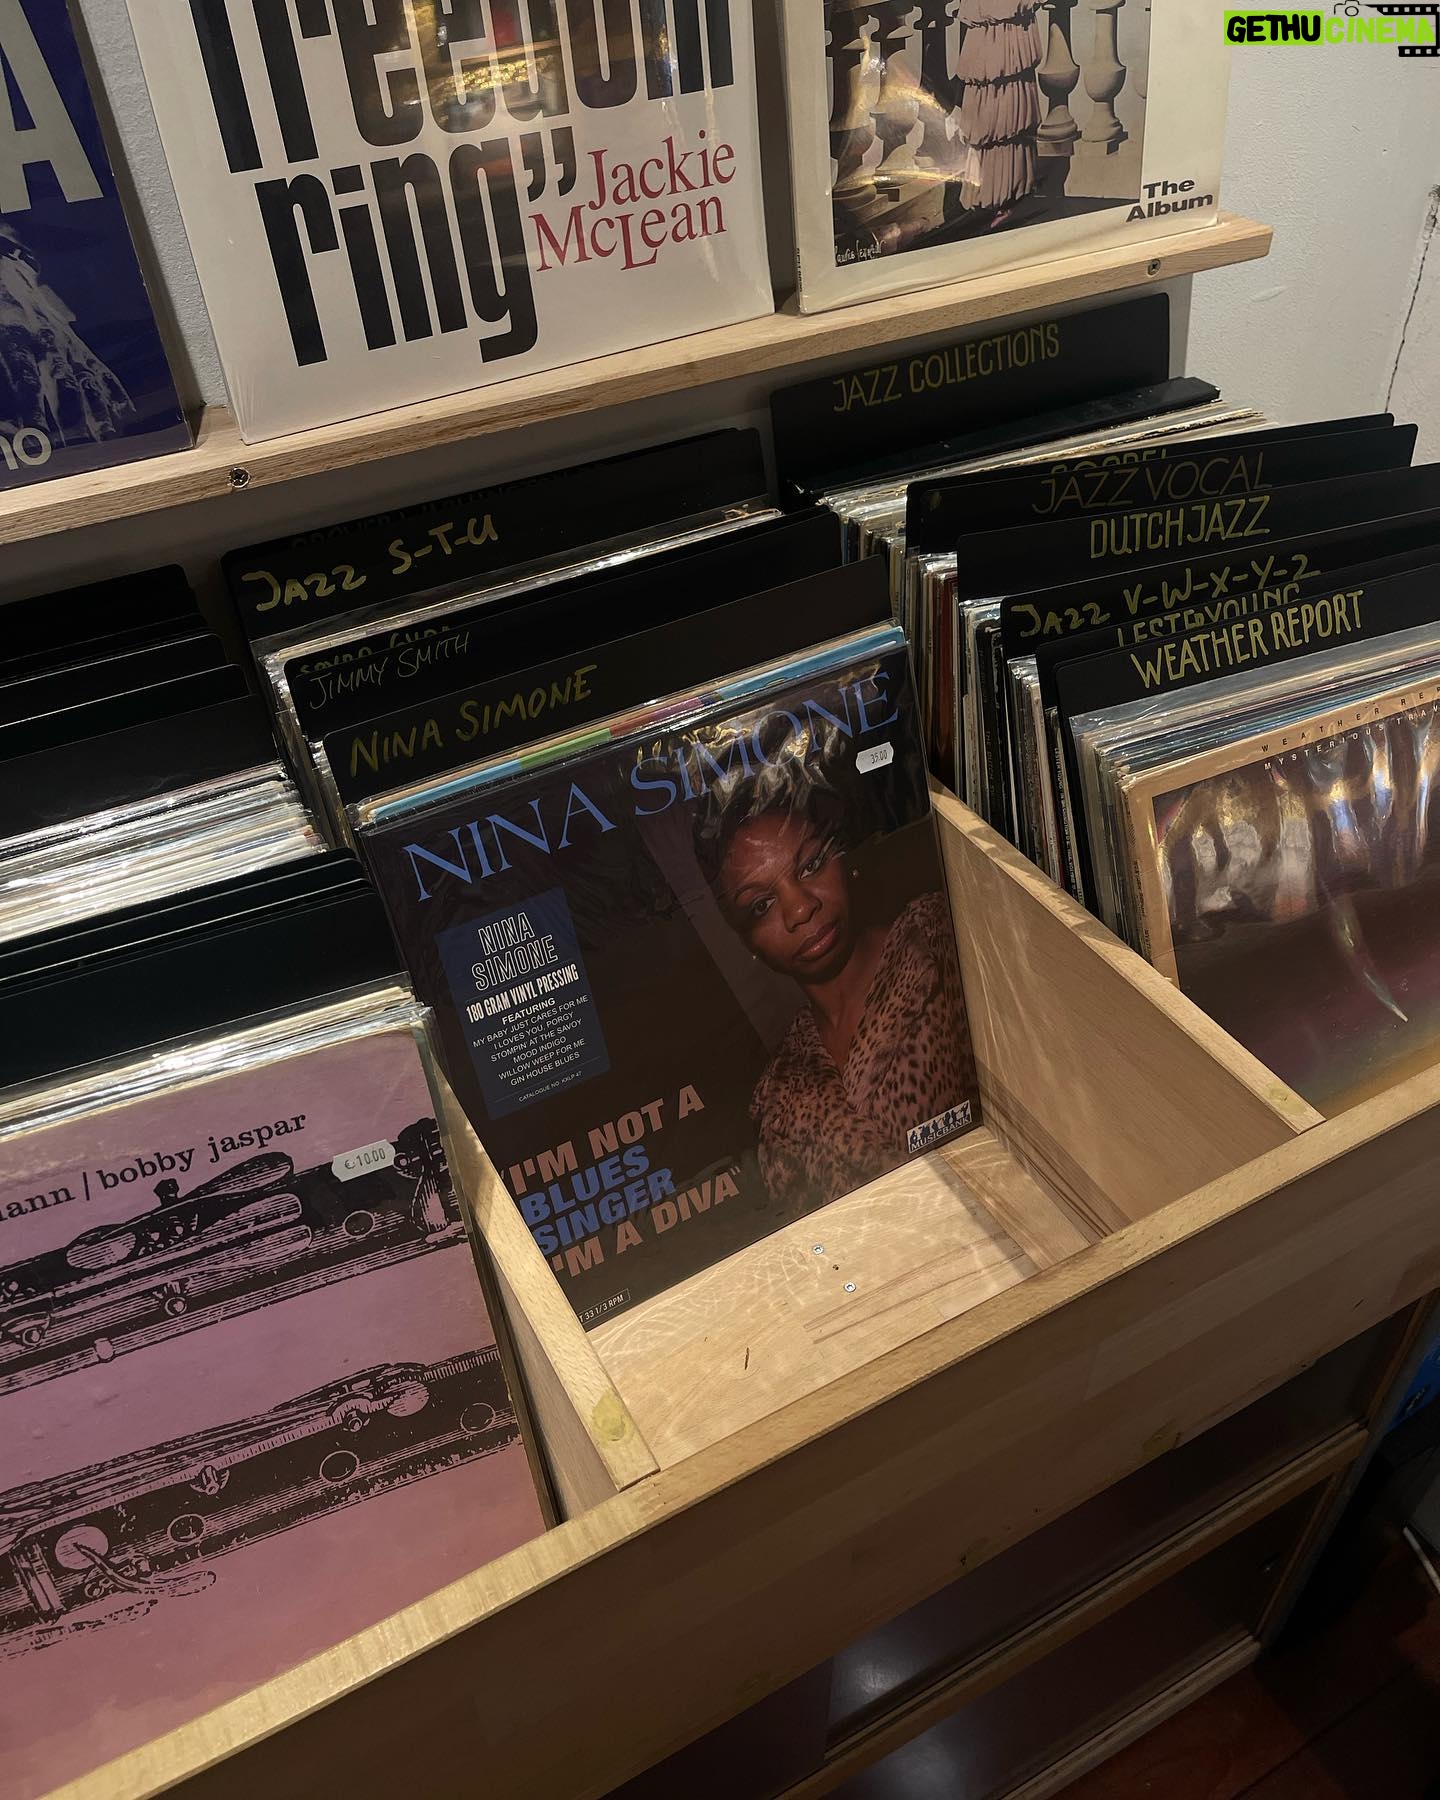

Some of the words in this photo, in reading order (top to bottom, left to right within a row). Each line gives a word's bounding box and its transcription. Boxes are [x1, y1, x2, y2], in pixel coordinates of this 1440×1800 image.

[585, 130, 737, 210] Jackie
[1143, 176, 1195, 199] The
[529, 196, 727, 272] McLean
[1126, 192, 1213, 223] Album
[832, 363, 904, 413] JAZZ
[908, 322, 1060, 394] COLLECTIONS
[1032, 467, 1140, 514] JAZZ
[1145, 451, 1273, 501] VOCAL
[1090, 505, 1184, 559] DUTCH
[1186, 495, 1271, 544] JAZZ
[1130, 618, 1270, 689] WEATHER
[1270, 589, 1364, 650] REPORT
[309, 656, 389, 710] JIMMY
[397, 631, 470, 678] SMITH
[350, 718, 444, 777] NINA
[455, 664, 598, 741] SIMONE
[1261, 707, 1380, 753] WEATHER
[1263, 723, 1386, 771] MYSTERIOUS
[403, 798, 617, 902] NINA
[630, 672, 898, 818] SIMONE
[471, 934, 559, 991] SIMONE
[477, 912, 535, 956] NINA
[466, 1001, 485, 1023] 180
[484, 990, 511, 1017] GRAM
[510, 980, 538, 1007] VINYL
[536, 963, 579, 995] PRESSING
[473, 1037, 486, 1048] MY
[486, 1028, 509, 1043] BABY
[510, 1019, 530, 1033] JUST
[531, 1008, 558, 1025] CARES
[558, 1001, 576, 1014] FOR
[575, 994, 589, 1008] ME
[501, 997, 556, 1025] FEATURING
[498, 1033, 525, 1048] LOVES
[546, 1011, 574, 1027] PORGY
[513, 1049, 539, 1064] MOOD
[539, 1036, 567, 1053] INDIGO
[529, 1037, 539, 1047] AT
[539, 1030, 556, 1043] THE
[556, 1018, 583, 1035] SAVOY
[498, 1061, 531, 1080] WILLOW
[531, 1052, 555, 1067] WEEP
[556, 1045, 573, 1058] FOR
[573, 1038, 586, 1050] ME
[510, 1075, 525, 1086] GIN
[525, 1063, 554, 1080] HOUSE
[554, 1051, 580, 1068] BLUES
[588, 1098, 664, 1160] NOT
[678, 1084, 705, 1120] A
[911, 1114, 970, 1150] MUSICBANK
[0, 1187, 75, 1222] ann
[96, 1149, 196, 1191] bobby
[208, 1113, 306, 1163] jaspar
[519, 1144, 650, 1227] BLUES
[532, 1167, 676, 1256] SINGER
[551, 1235, 605, 1278] 'M
[616, 1220, 643, 1255] A
[651, 1165, 741, 1234] DIVA"
[585, 1308, 595, 1320] 33
[595, 1302, 608, 1317] 1/3
[608, 1294, 624, 1309] RPM
